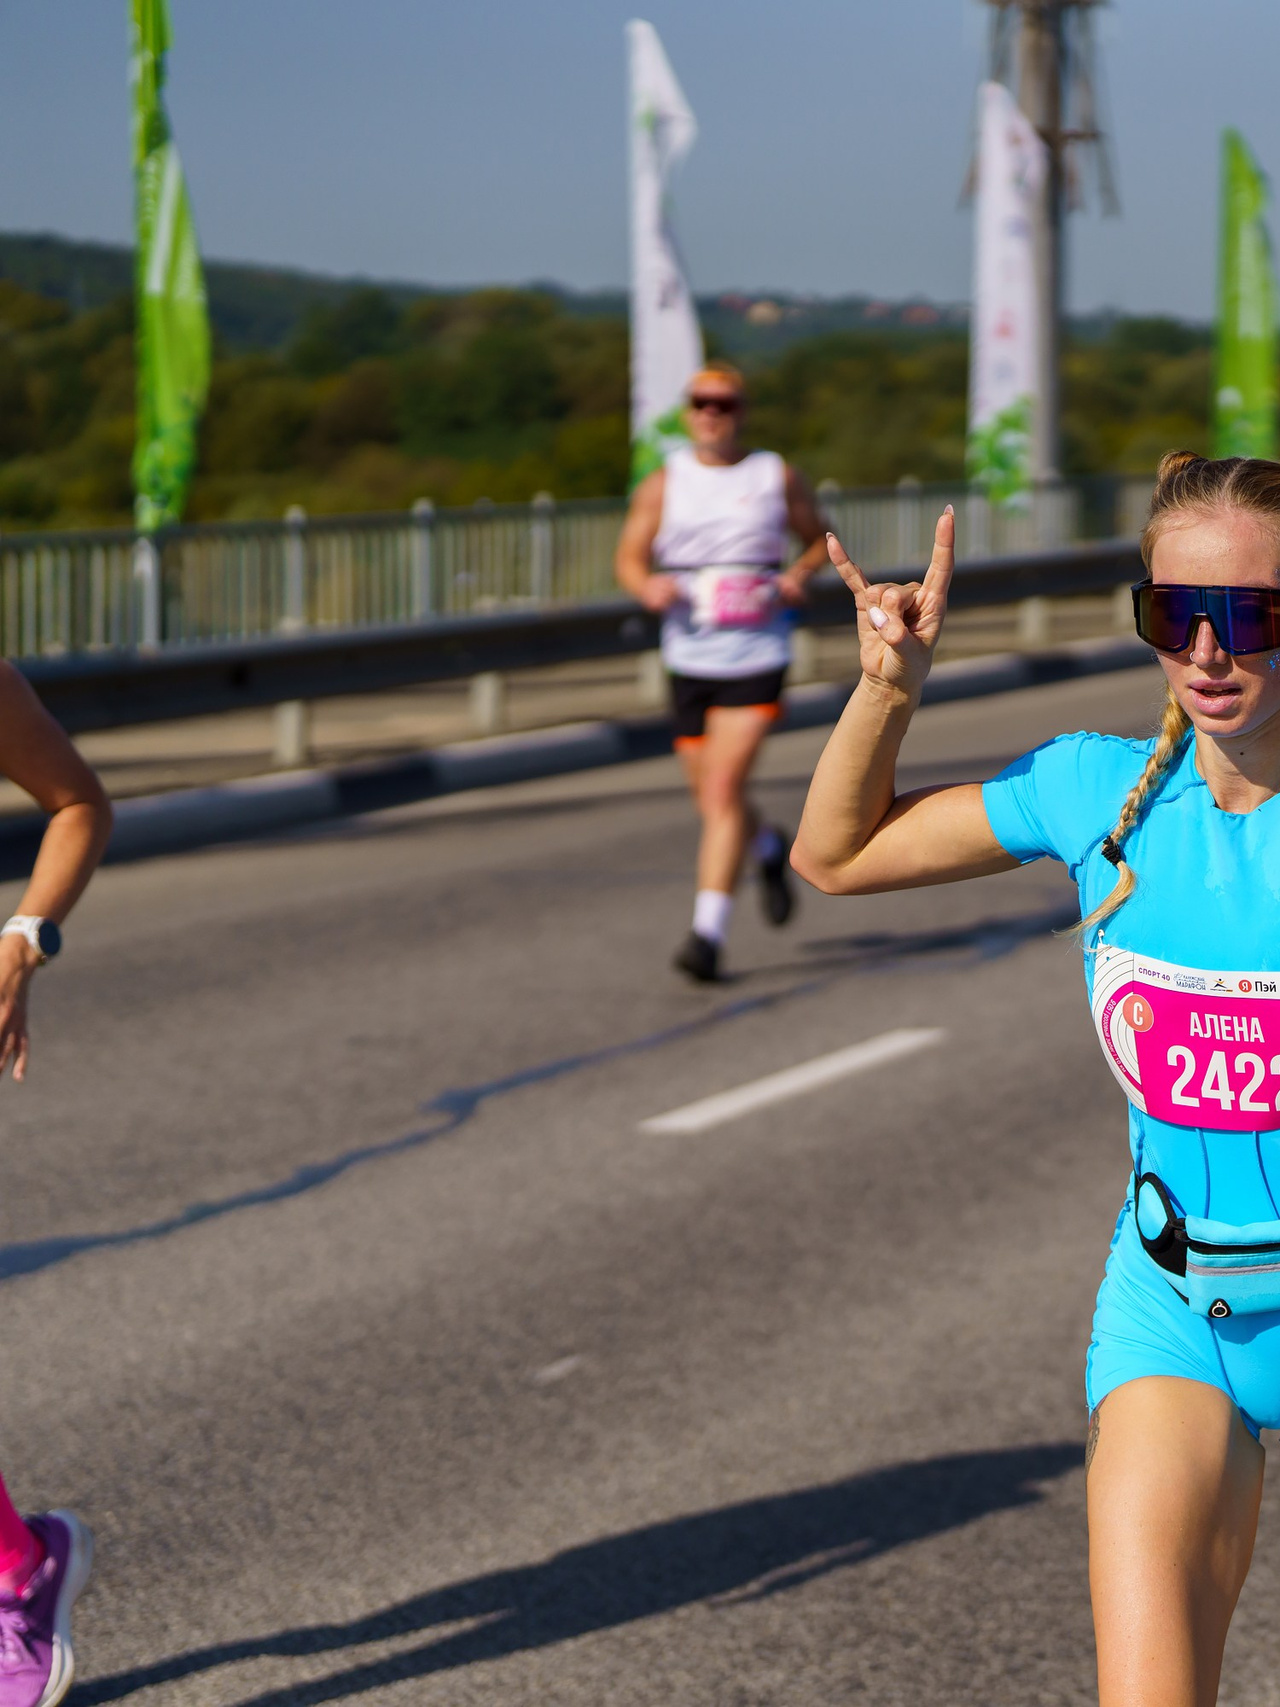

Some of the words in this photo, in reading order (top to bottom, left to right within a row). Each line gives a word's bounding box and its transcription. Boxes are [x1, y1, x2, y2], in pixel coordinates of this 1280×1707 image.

[1138, 967, 1161, 979] СПОРТ
[1176, 980, 1206, 990] МАРАФОН
[1254, 980, 1277, 992] Пэй
[1190, 1012, 1265, 1043] АЛЕНА
